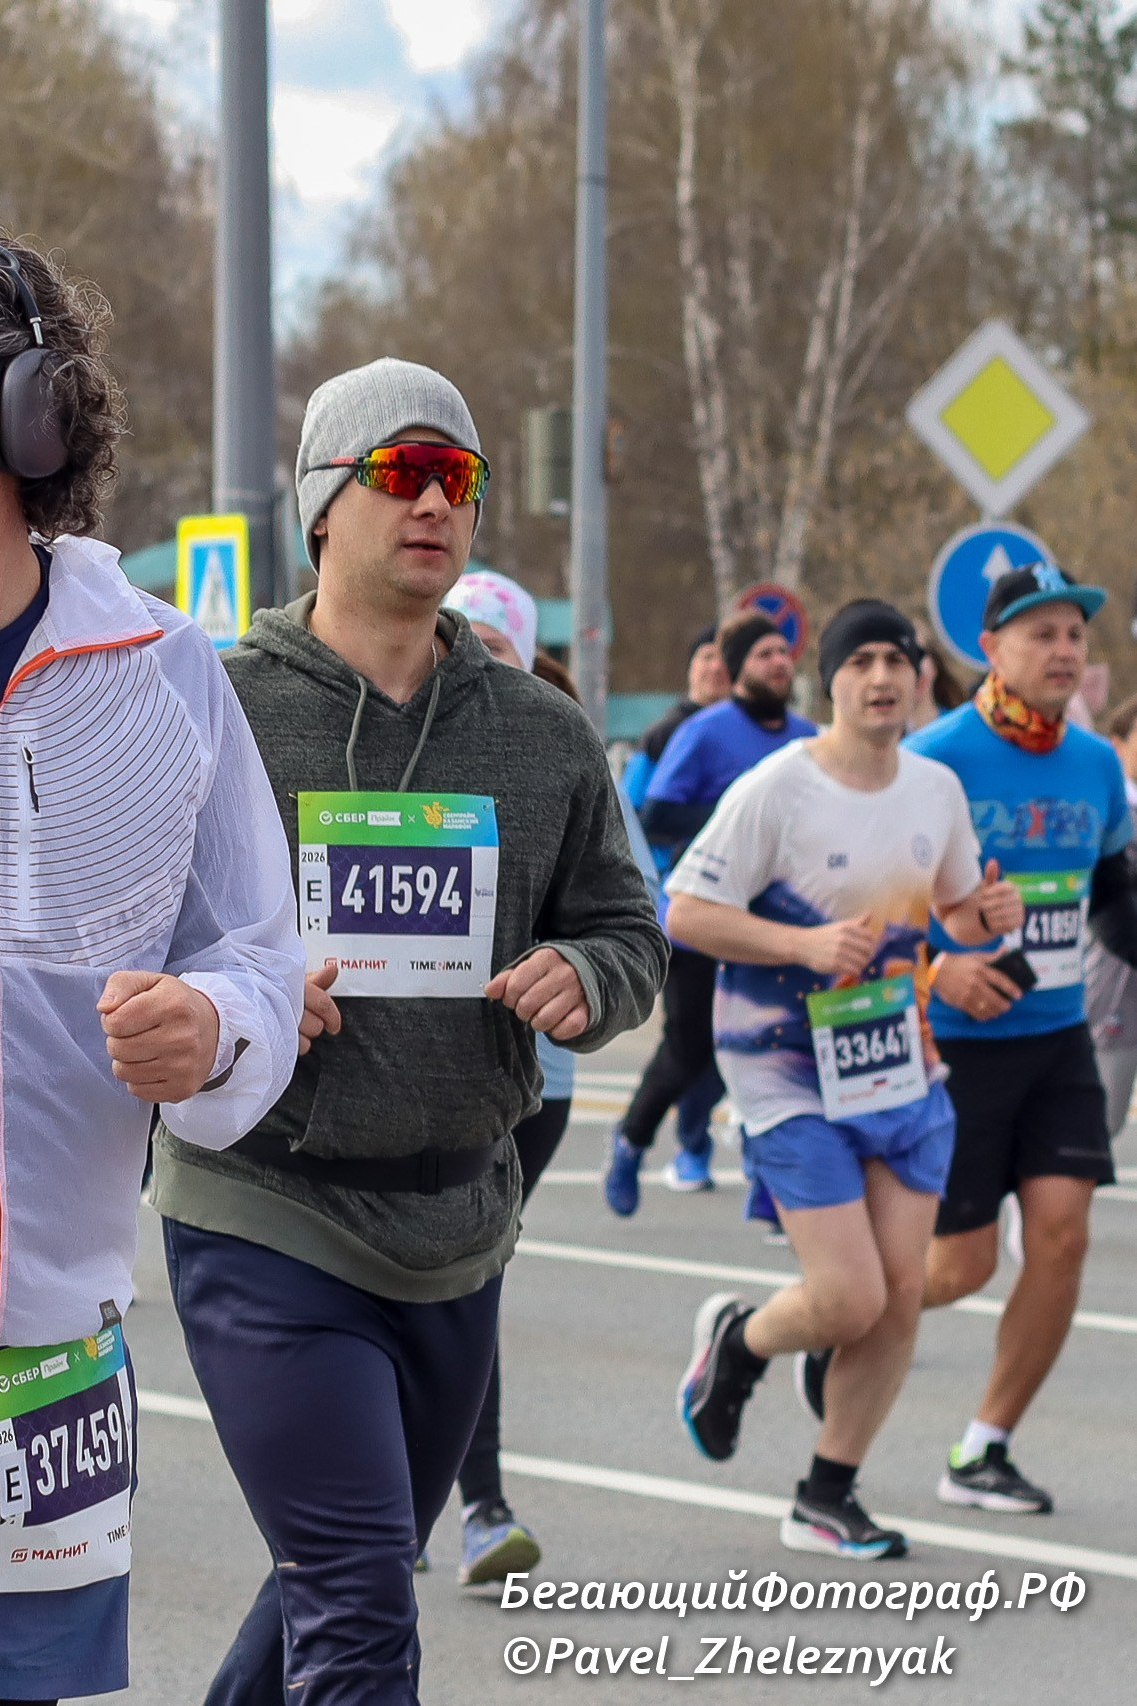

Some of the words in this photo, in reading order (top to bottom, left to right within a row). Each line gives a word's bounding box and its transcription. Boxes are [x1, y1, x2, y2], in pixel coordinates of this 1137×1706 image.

[335, 813, 366, 824] СБЕР
[301, 851, 326, 863] 2026
[341, 864, 463, 915] 41594
[340, 959, 388, 971] МАГНИТ
[11, 1366, 40, 1386] СБЕР
[31, 1402, 123, 1497] 37459
[106, 1524, 130, 1544] TIME
[31, 1541, 89, 1561] МАГНИТ
